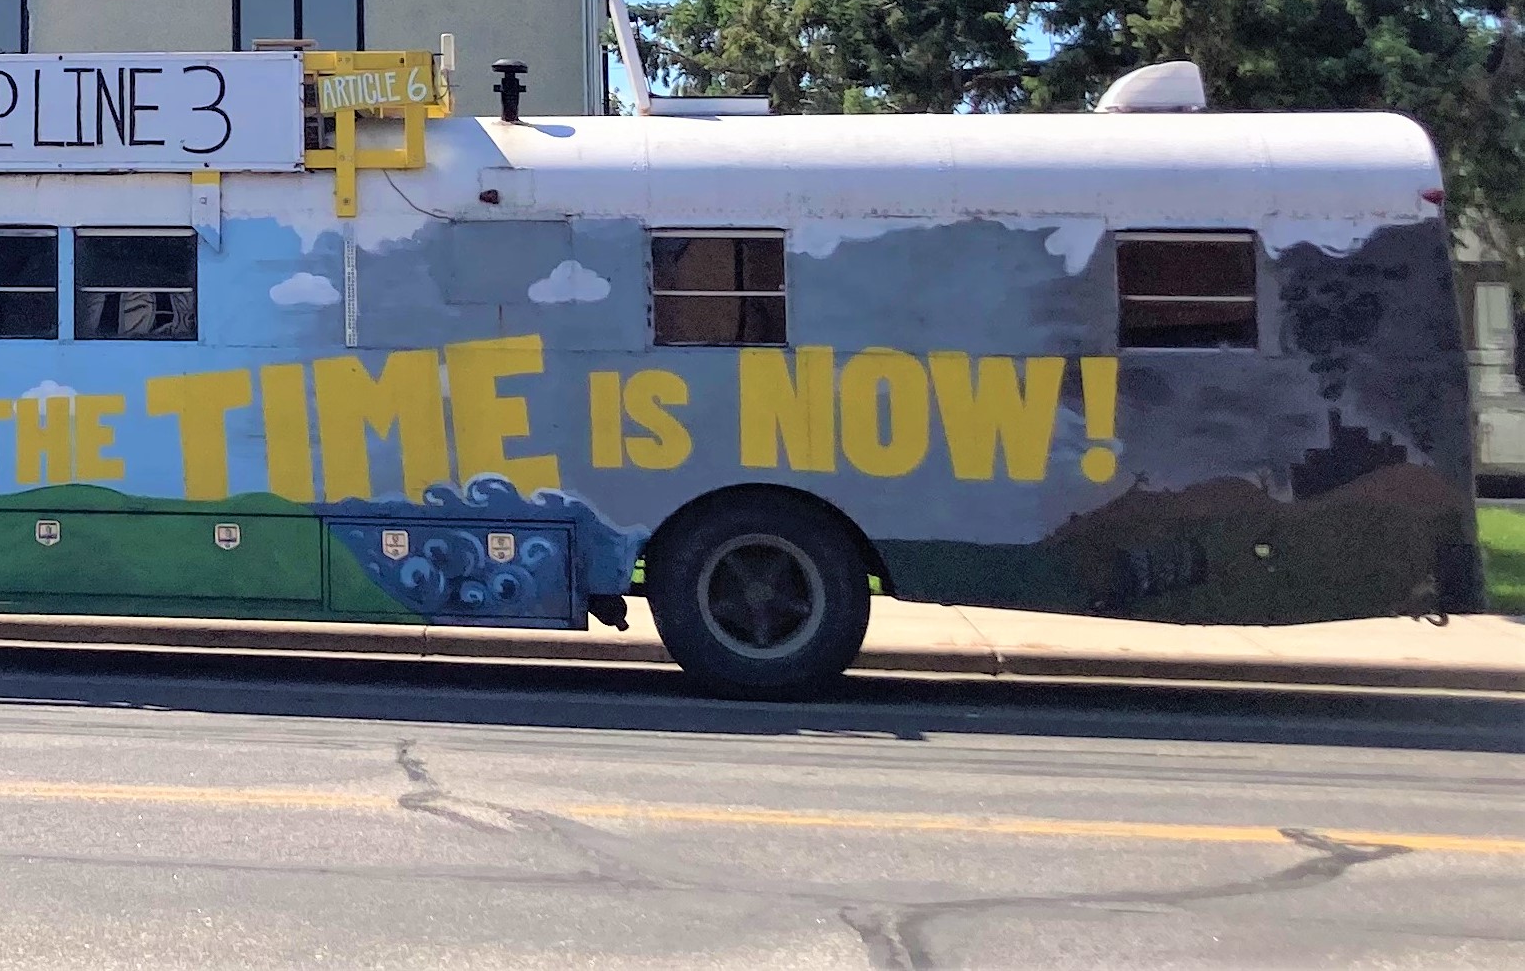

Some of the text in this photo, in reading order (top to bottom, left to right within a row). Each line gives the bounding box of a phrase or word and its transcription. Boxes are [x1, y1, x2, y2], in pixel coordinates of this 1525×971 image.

[33, 67, 166, 148] LINE
[181, 65, 232, 154] 3
[323, 67, 427, 110] ARTICLE 6
[146, 334, 561, 505] TIME
[588, 369, 693, 471] IS
[739, 344, 1119, 484] NOW!
